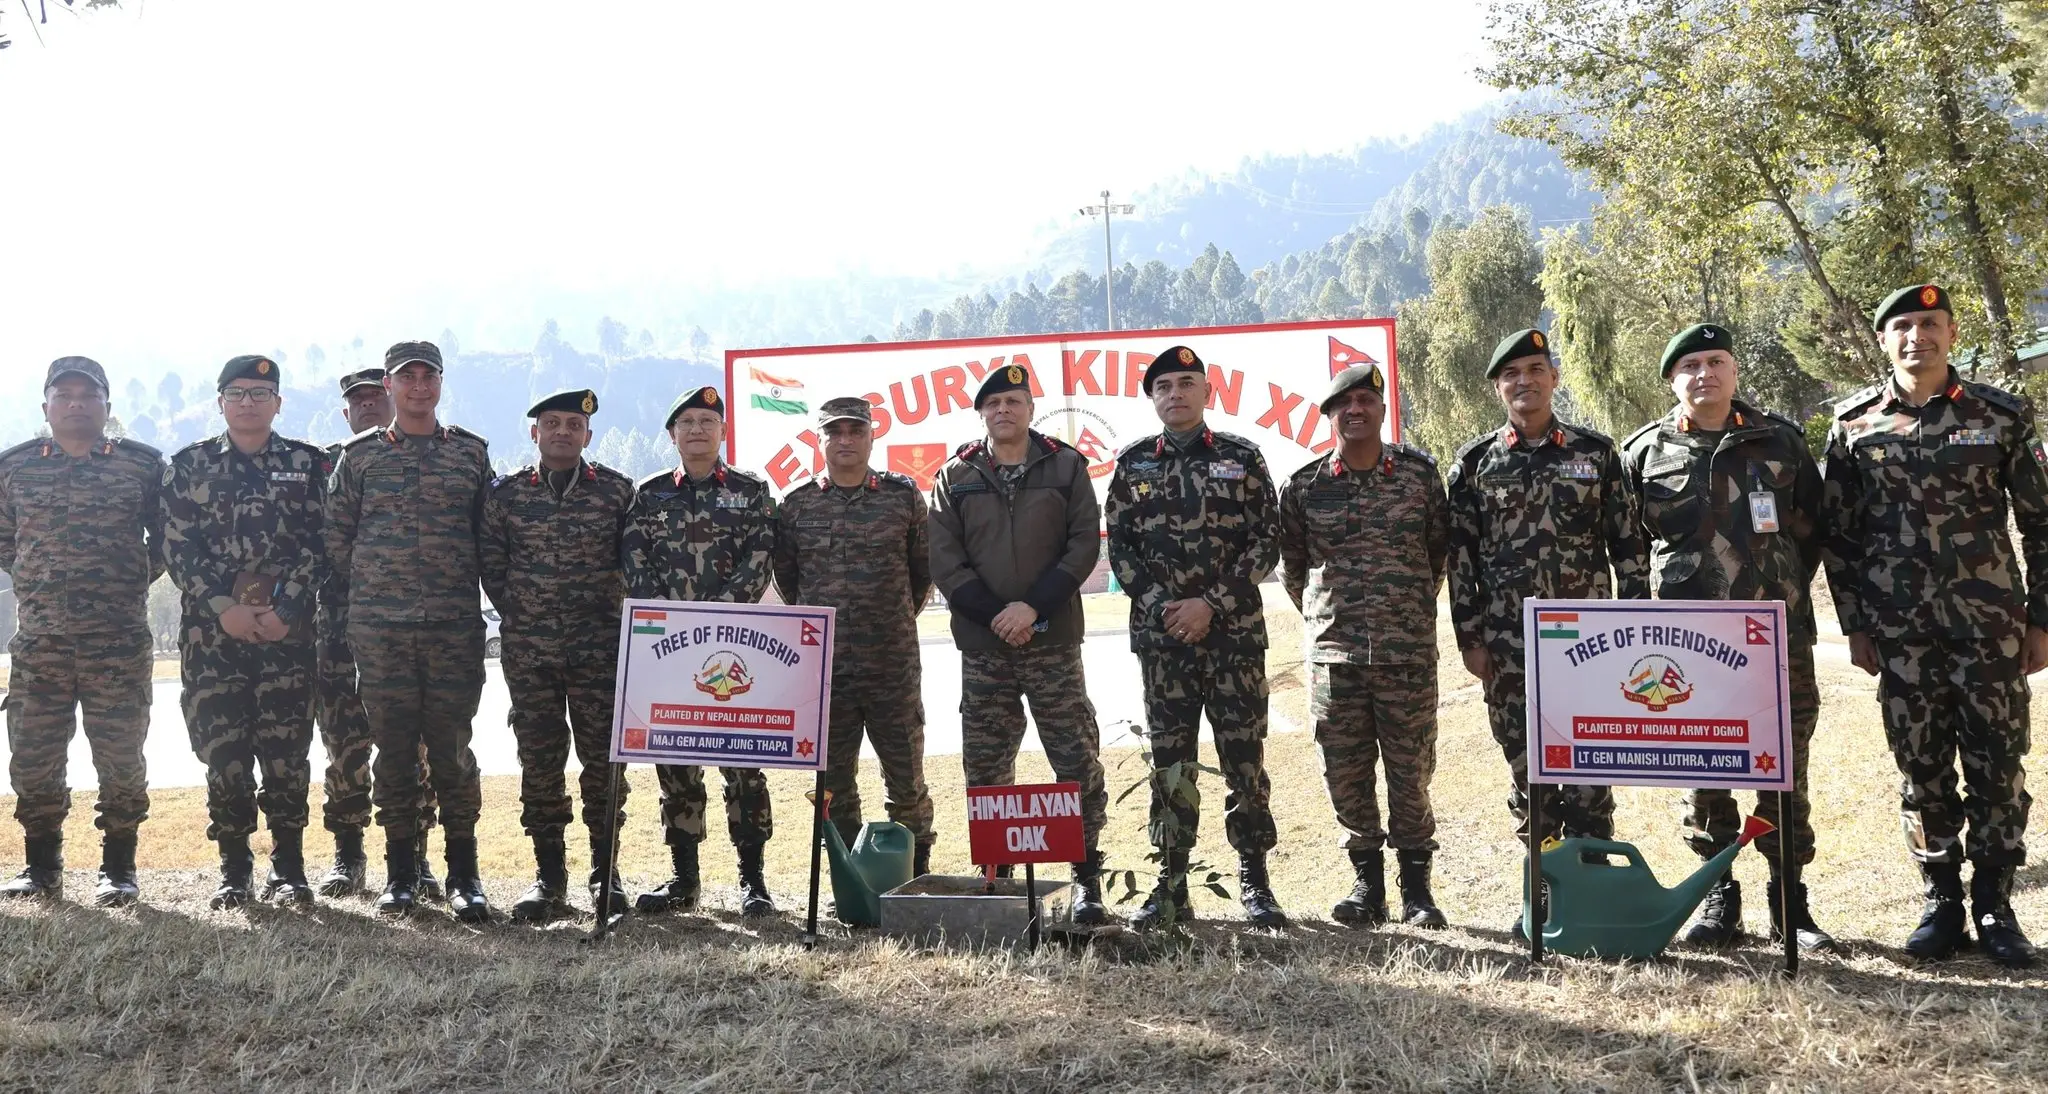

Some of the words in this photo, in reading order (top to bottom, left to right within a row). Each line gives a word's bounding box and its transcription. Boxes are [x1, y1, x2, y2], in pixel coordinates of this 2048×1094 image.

[1061, 349, 1245, 416] KIRN
[1049, 407, 1081, 417] COMBINED
[651, 630, 689, 660] TREE
[693, 625, 712, 645] OF
[716, 625, 801, 668] FRIENDSHIP
[1564, 632, 1610, 668] TREE
[1613, 626, 1637, 649] OF
[1641, 625, 1749, 671] FRIENDSHIP
[654, 709, 691, 721] PLANTED
[693, 711, 705, 721] BY
[707, 711, 736, 723] NEPALI
[738, 713, 763, 724] ARMY
[765, 714, 791, 726] DGMO
[1577, 722, 1622, 735] PLANTED
[1625, 723, 1638, 735] BY
[1641, 724, 1677, 736] INDIAN
[1679, 725, 1710, 737] ARMY
[1712, 725, 1744, 738] DGMO
[652, 734, 674, 747] MAJ
[676, 735, 697, 747] GEN
[699, 736, 725, 749] ANUP
[727, 737, 754, 751] JUNG
[756, 739, 788, 752] THAPA
[1578, 751, 1589, 764] LT
[1591, 752, 1614, 765] GEN
[1616, 752, 1659, 766] MANISH
[1662, 753, 1708, 769] LUTHRA,
[1710, 754, 1743, 768] AVSM
[968, 792, 1080, 820] HIMALAYAN
[1006, 825, 1049, 852] OAK
